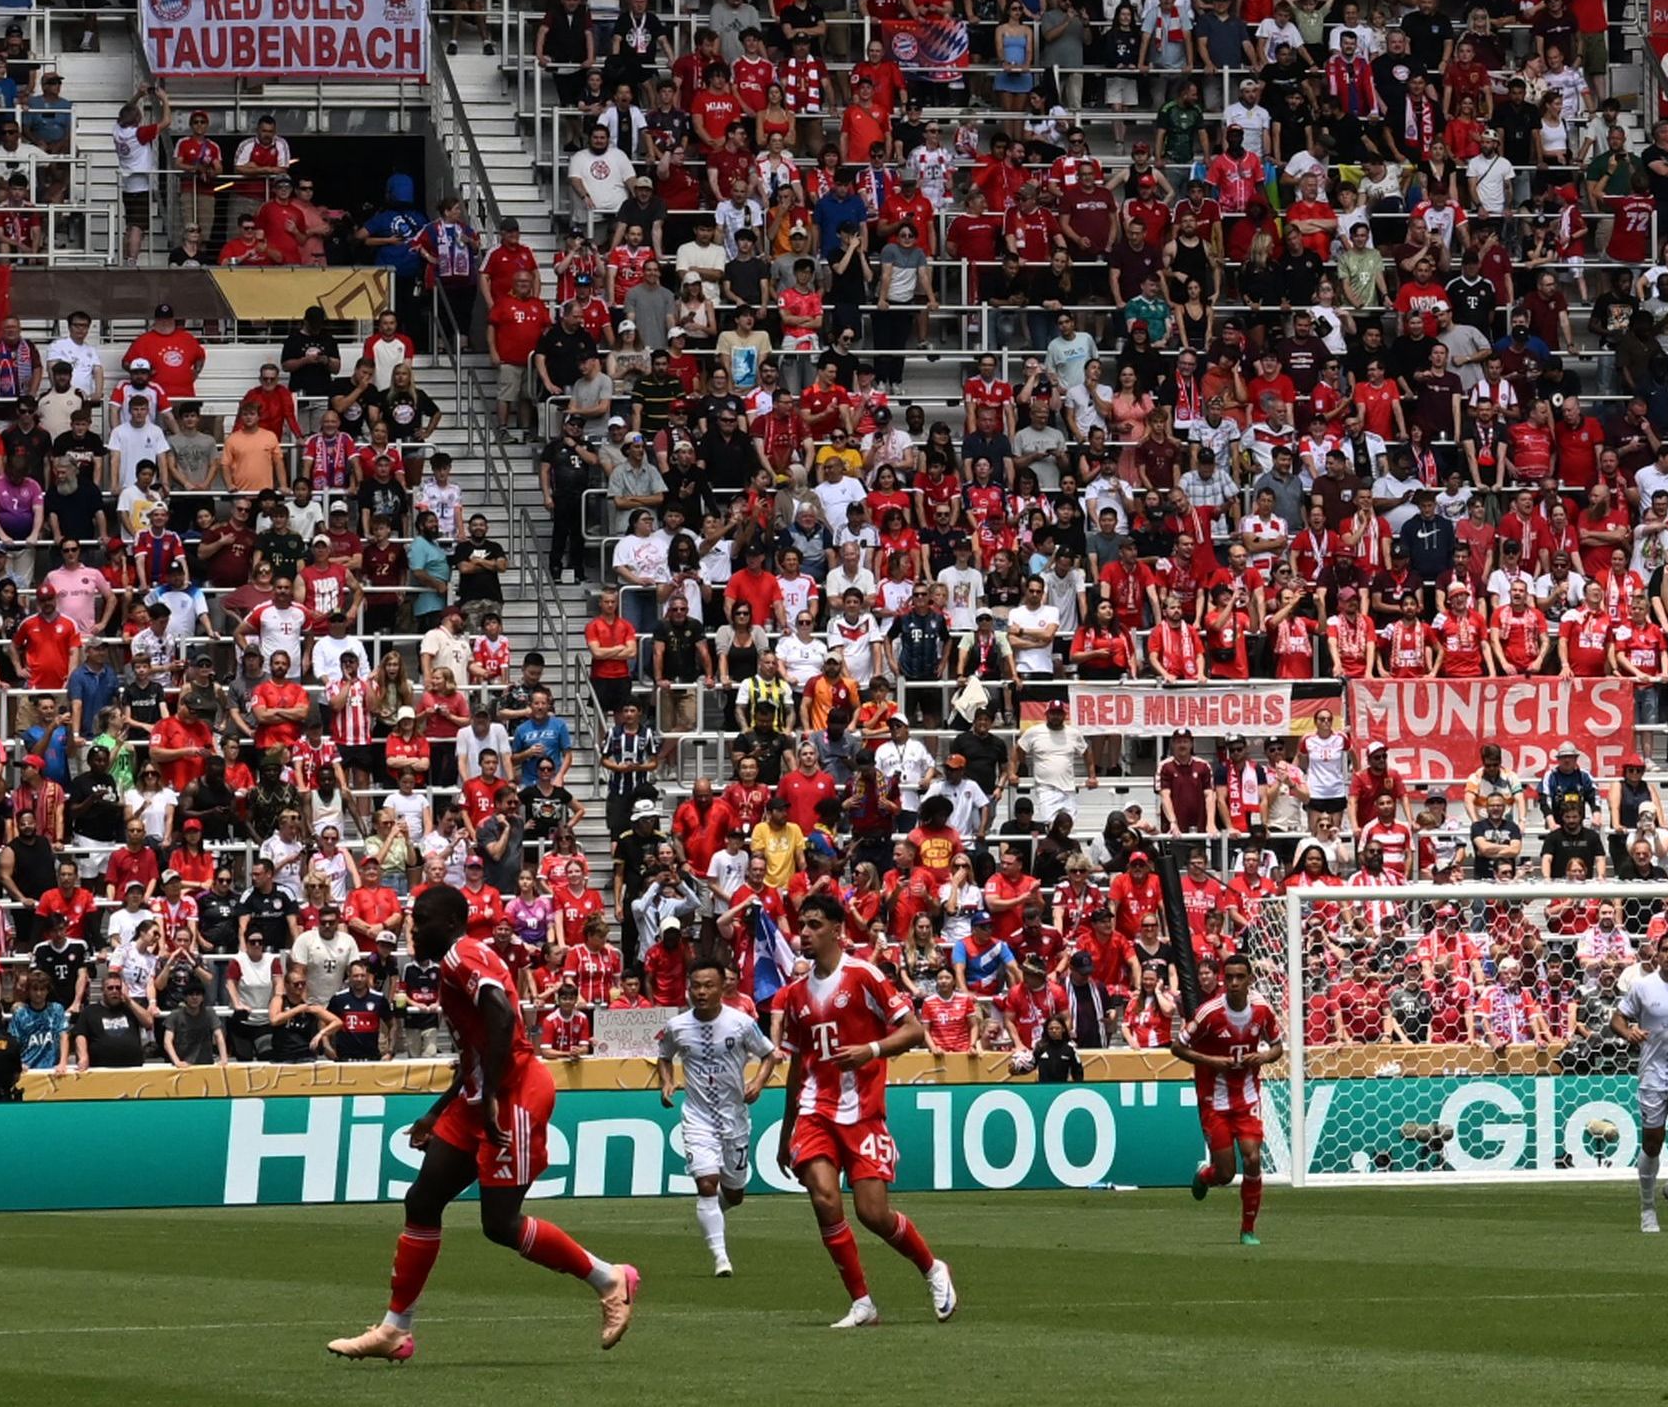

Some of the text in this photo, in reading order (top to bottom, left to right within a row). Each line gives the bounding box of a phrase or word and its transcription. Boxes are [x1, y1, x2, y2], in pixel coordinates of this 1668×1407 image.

[147, 26, 421, 70] TAUBENBACH
[1624, 211, 1650, 232] 72
[1076, 694, 1133, 726] RED
[597, 1008, 668, 1027] JAMAL
[27, 1032, 54, 1046] AIA
[860, 1133, 899, 1164] 45
[916, 1081, 1158, 1191] 100"
